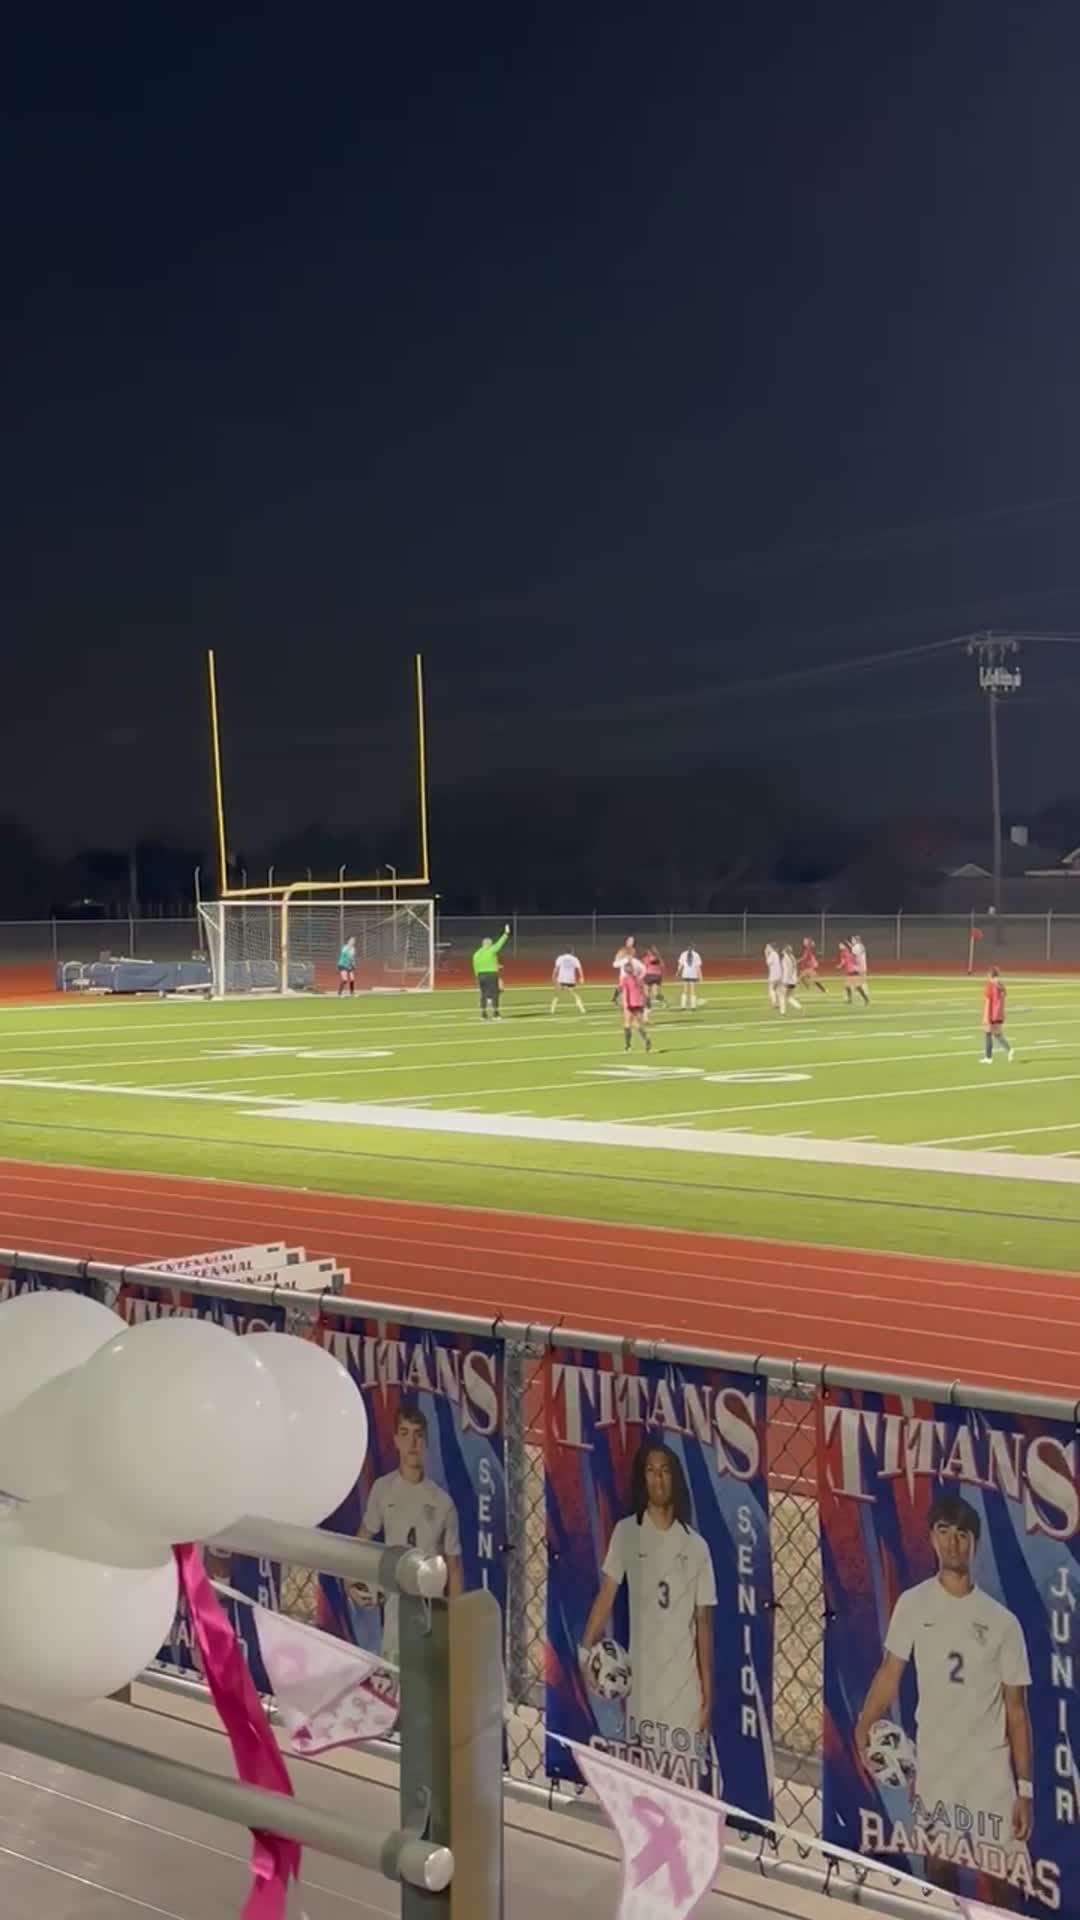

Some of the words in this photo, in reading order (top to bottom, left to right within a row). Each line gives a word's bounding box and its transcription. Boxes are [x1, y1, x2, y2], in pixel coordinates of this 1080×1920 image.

[323, 1330, 499, 1436] TITANS
[552, 1363, 760, 1480] TITANS
[478, 1457, 493, 1590] SENI
[824, 1406, 1080, 1539] TITANS
[658, 1580, 671, 1610] 3
[737, 1505, 757, 1739] SENIOR
[948, 1650, 965, 1685] 2
[1051, 1567, 1074, 1824] JUNIOR
[859, 1808, 1060, 1910] RAMADAS
[912, 1795, 1003, 1840] AADIT
